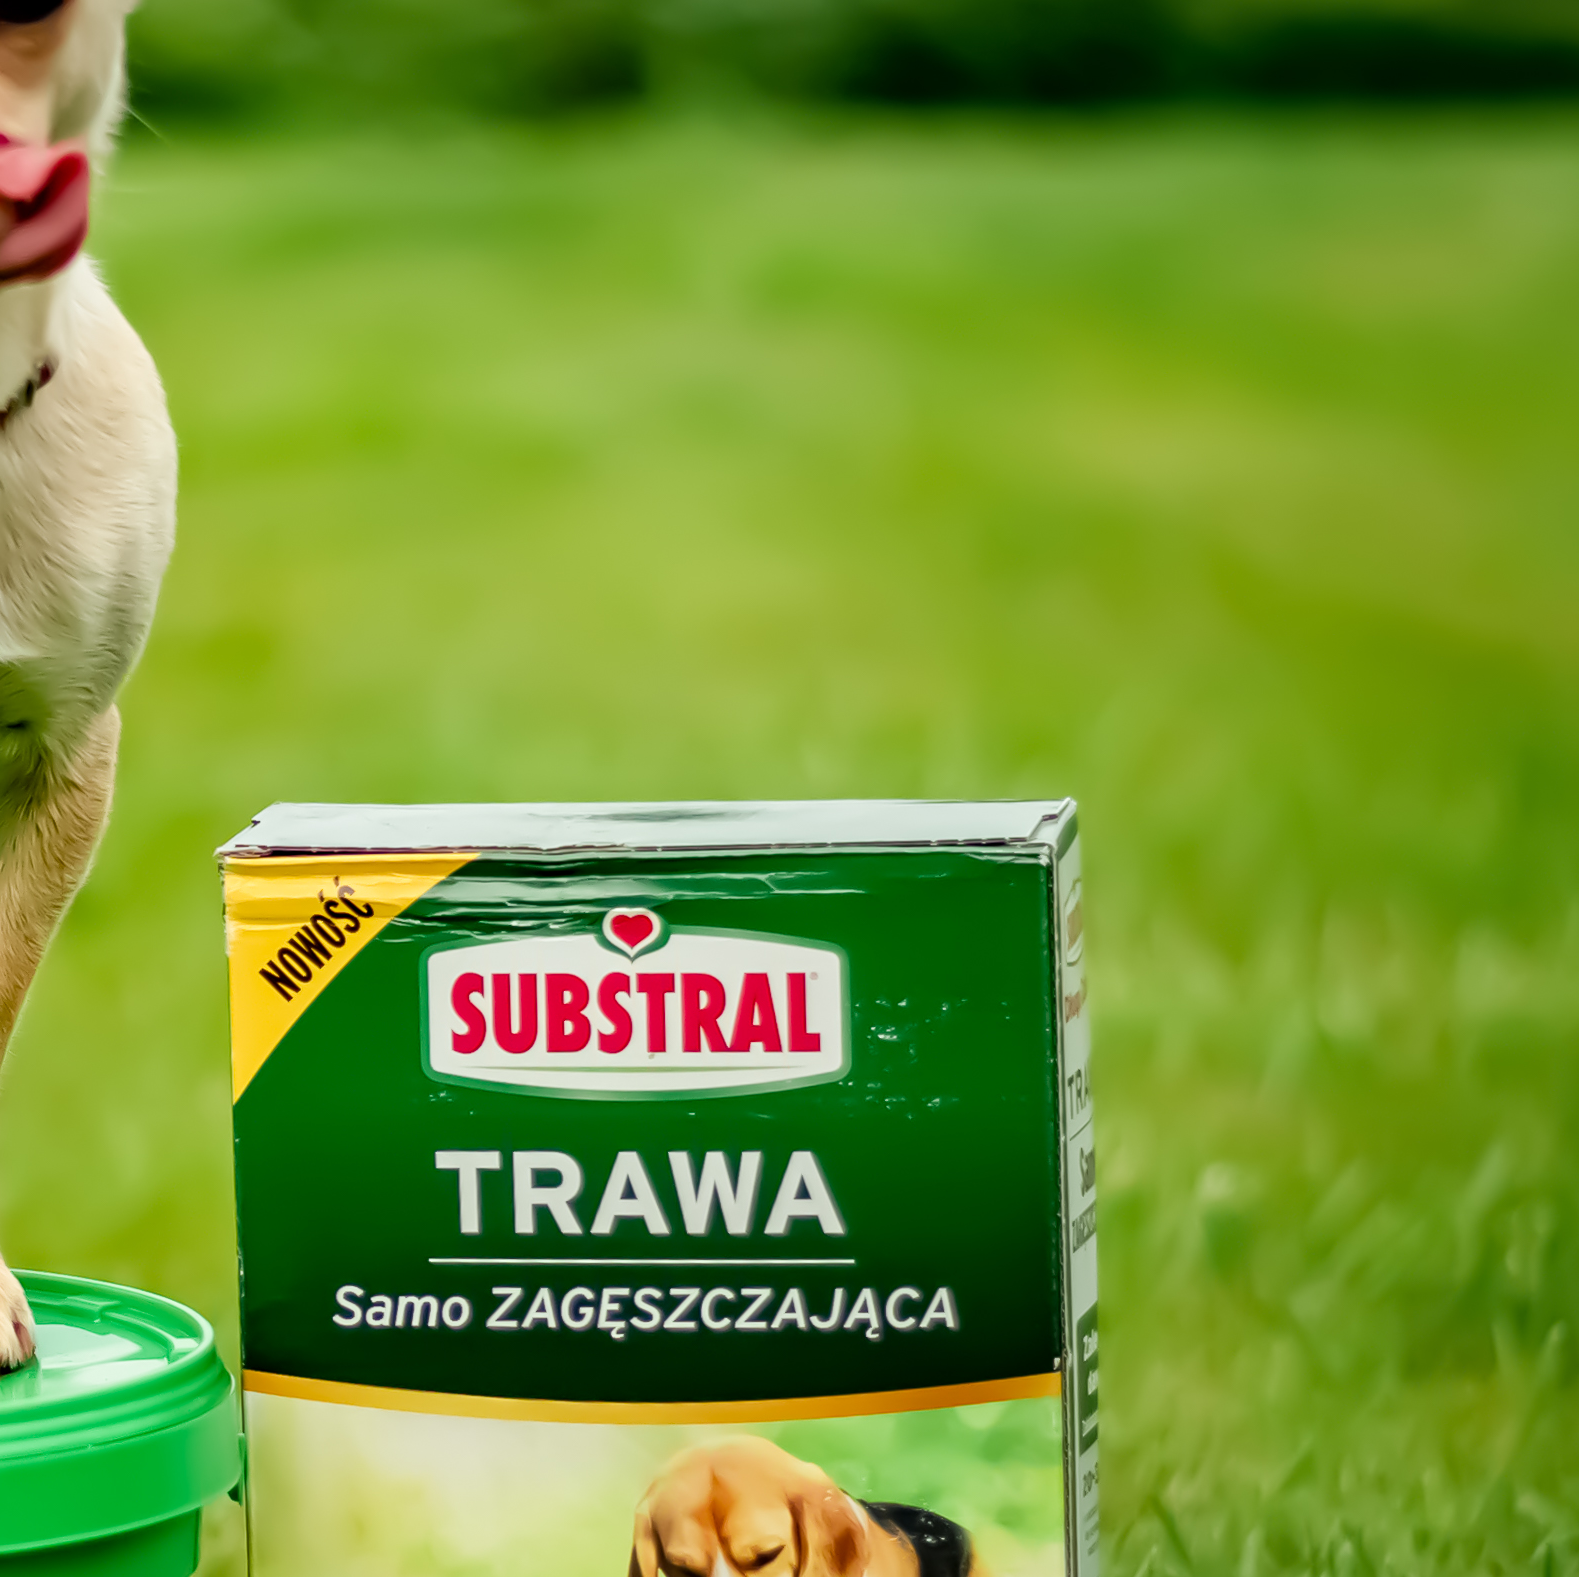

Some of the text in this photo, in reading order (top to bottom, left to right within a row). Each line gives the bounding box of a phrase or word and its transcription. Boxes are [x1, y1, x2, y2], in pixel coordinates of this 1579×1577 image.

[258, 875, 375, 1002] NOWOŚĆ
[451, 971, 821, 1055] SUBSTRAL
[434, 1150, 847, 1236] TRAWA
[331, 1284, 962, 1340] Samo ZAGĘSZCZAJĄCA
